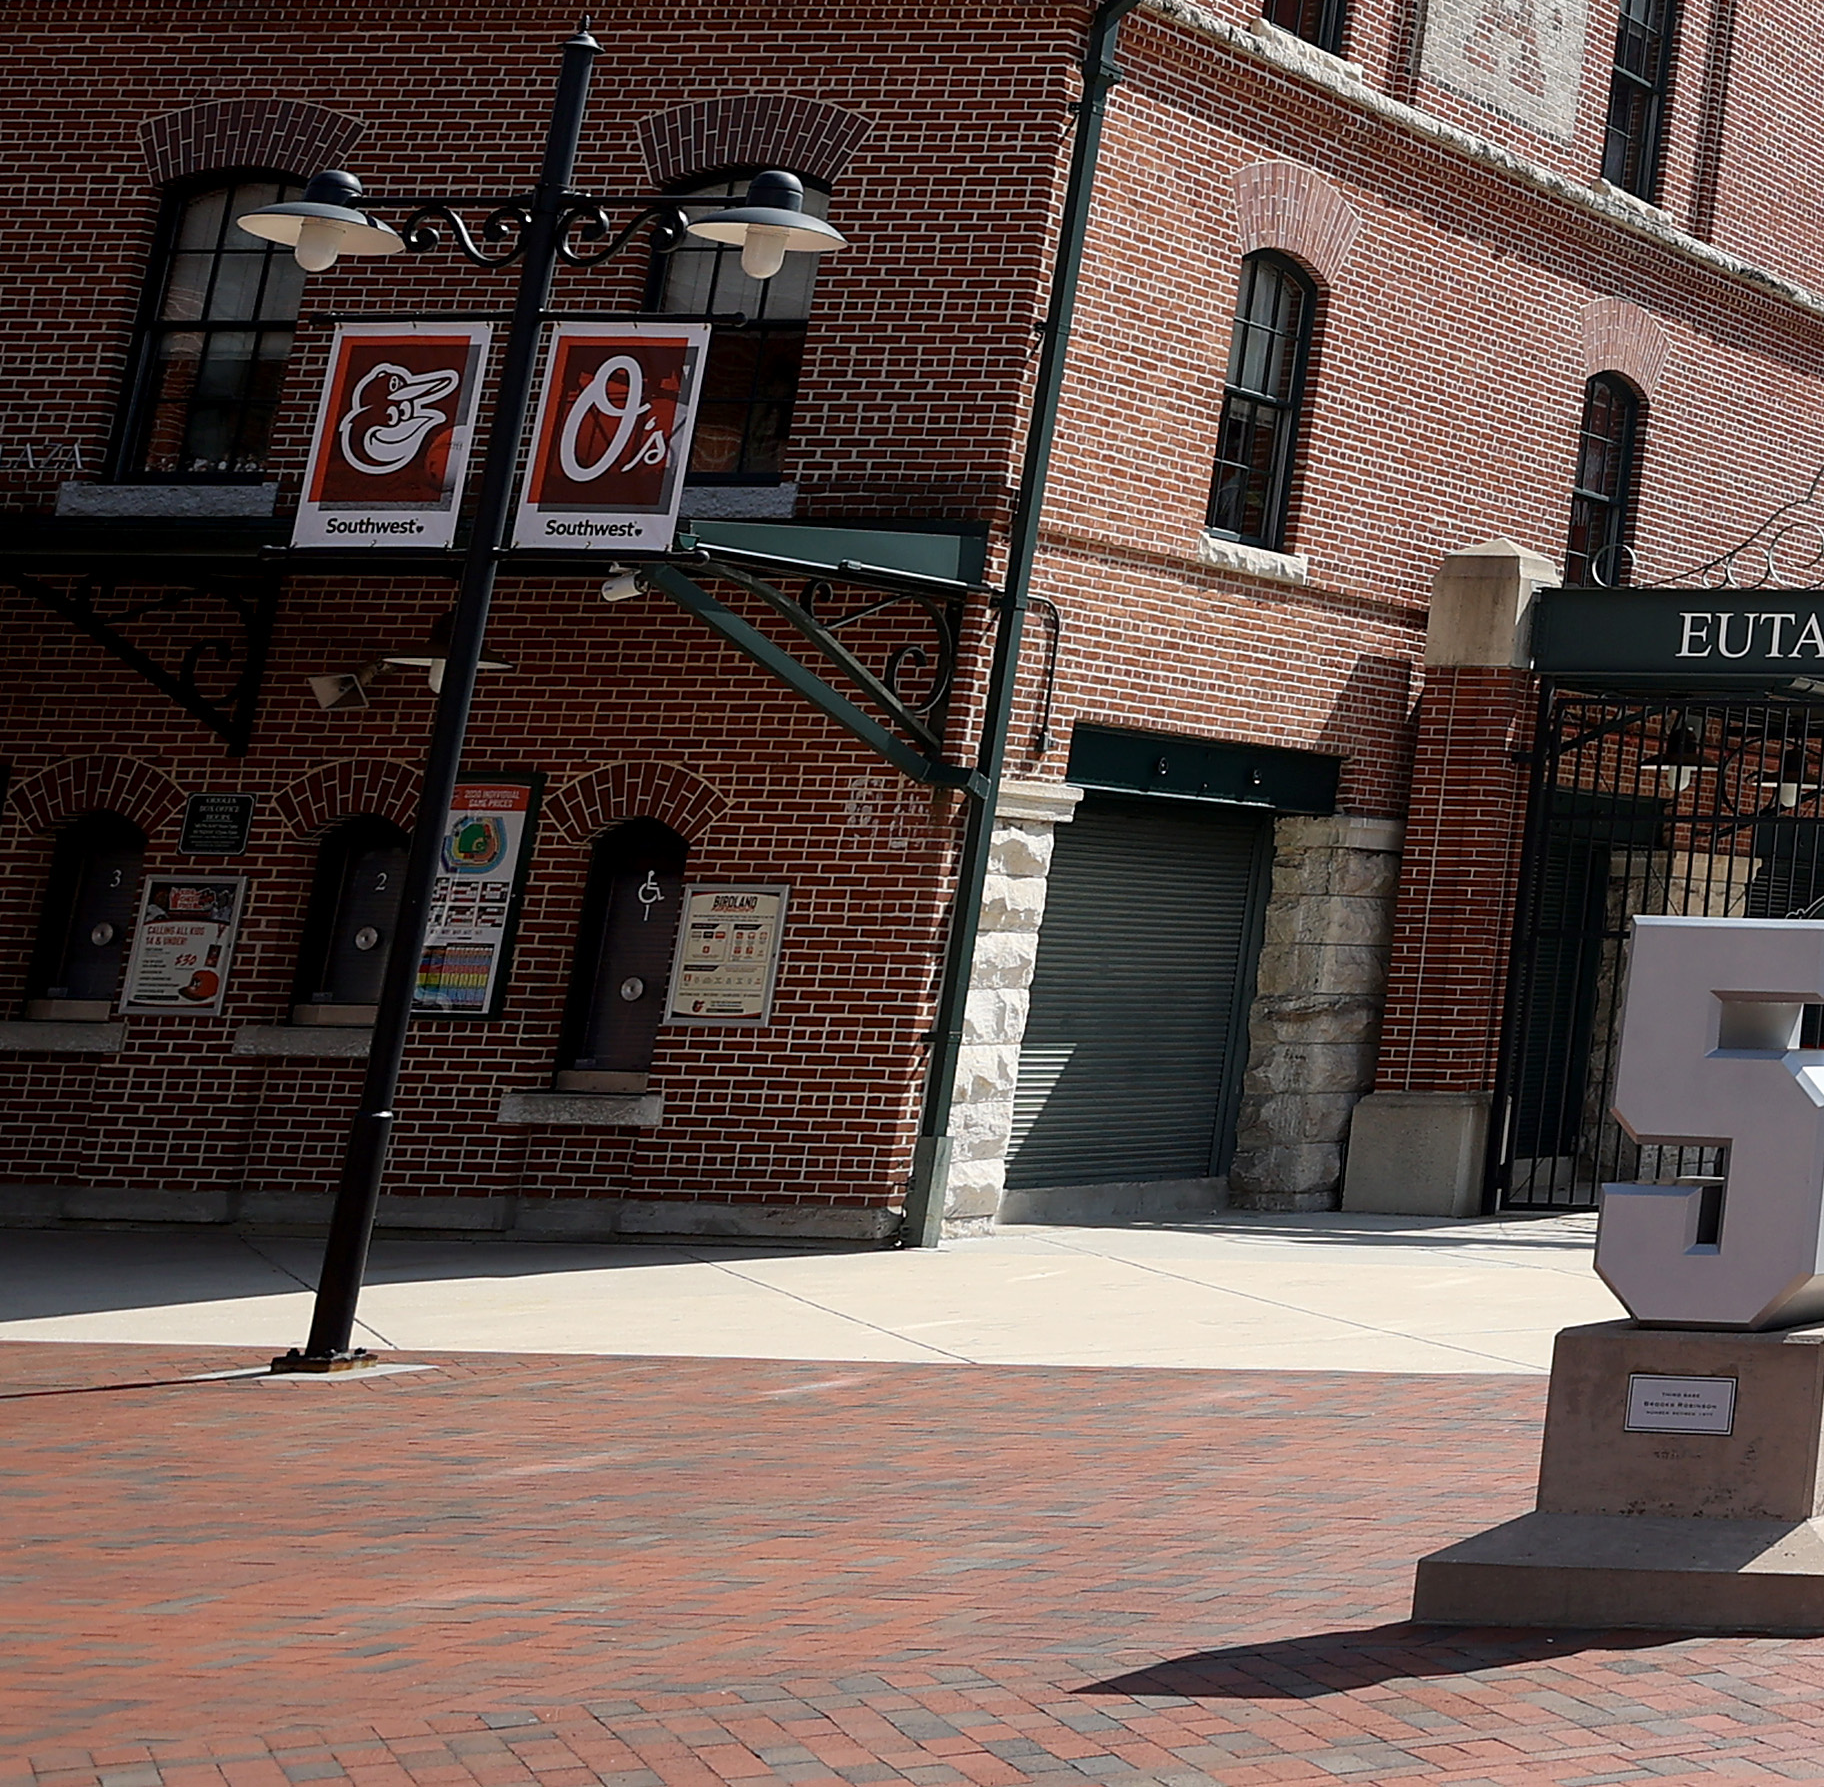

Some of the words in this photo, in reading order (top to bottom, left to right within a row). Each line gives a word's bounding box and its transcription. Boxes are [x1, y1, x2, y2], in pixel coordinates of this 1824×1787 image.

[560, 355, 671, 483] O's
[326, 516, 417, 535] Southwest
[545, 519, 636, 538] Southwest
[109, 869, 122, 889] 3
[374, 872, 388, 891] 2
[713, 896, 758, 908] BIRDLAND
[174, 954, 197, 966] $30
